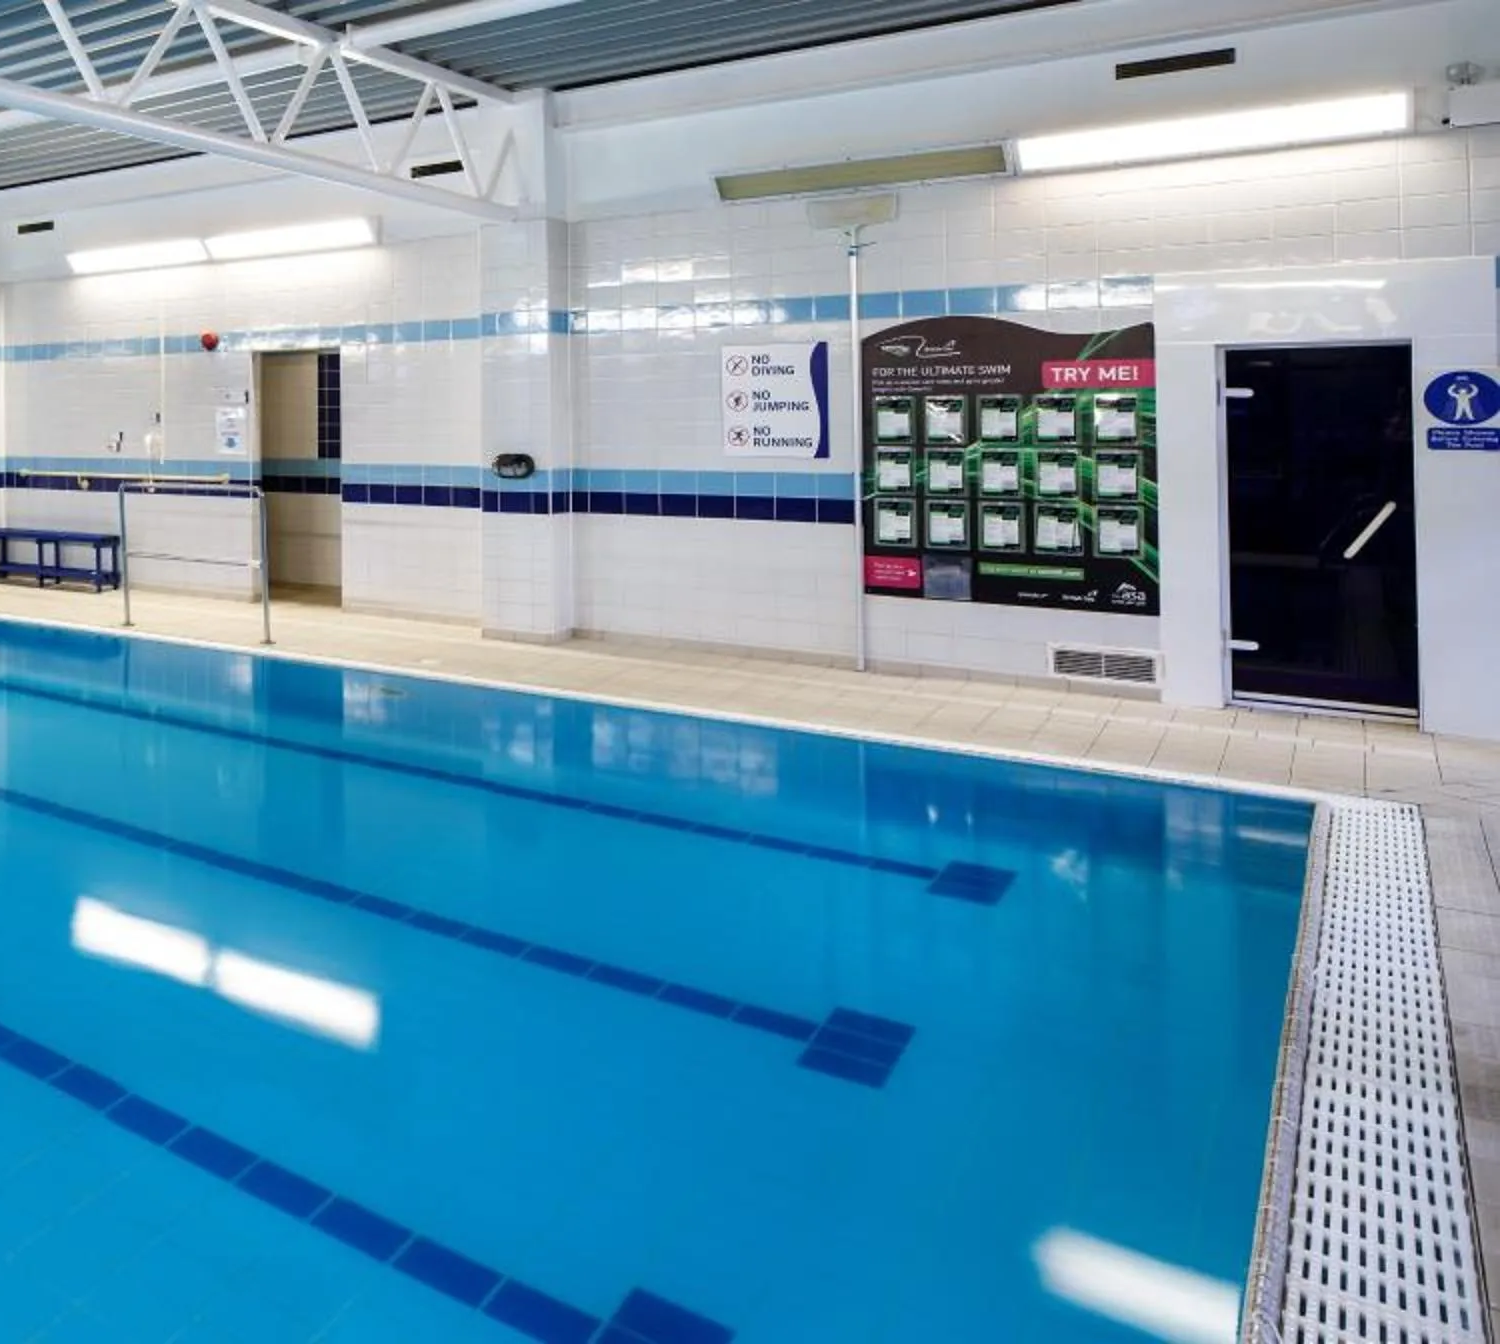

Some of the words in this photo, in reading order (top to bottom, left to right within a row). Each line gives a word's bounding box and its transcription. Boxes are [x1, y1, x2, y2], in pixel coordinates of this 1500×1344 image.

[751, 354, 771, 365] NO
[751, 365, 795, 377] DIVING
[871, 366, 896, 377] FOR
[897, 366, 916, 377] THE
[921, 365, 976, 377] ULTIMATE
[979, 363, 1011, 375] SWIM
[1051, 366, 1091, 383] TRY
[1098, 365, 1139, 381] ME!
[752, 389, 771, 401] NO
[752, 401, 810, 412] JUMPING
[753, 425, 771, 437] NO
[753, 437, 813, 448] RUNNING
